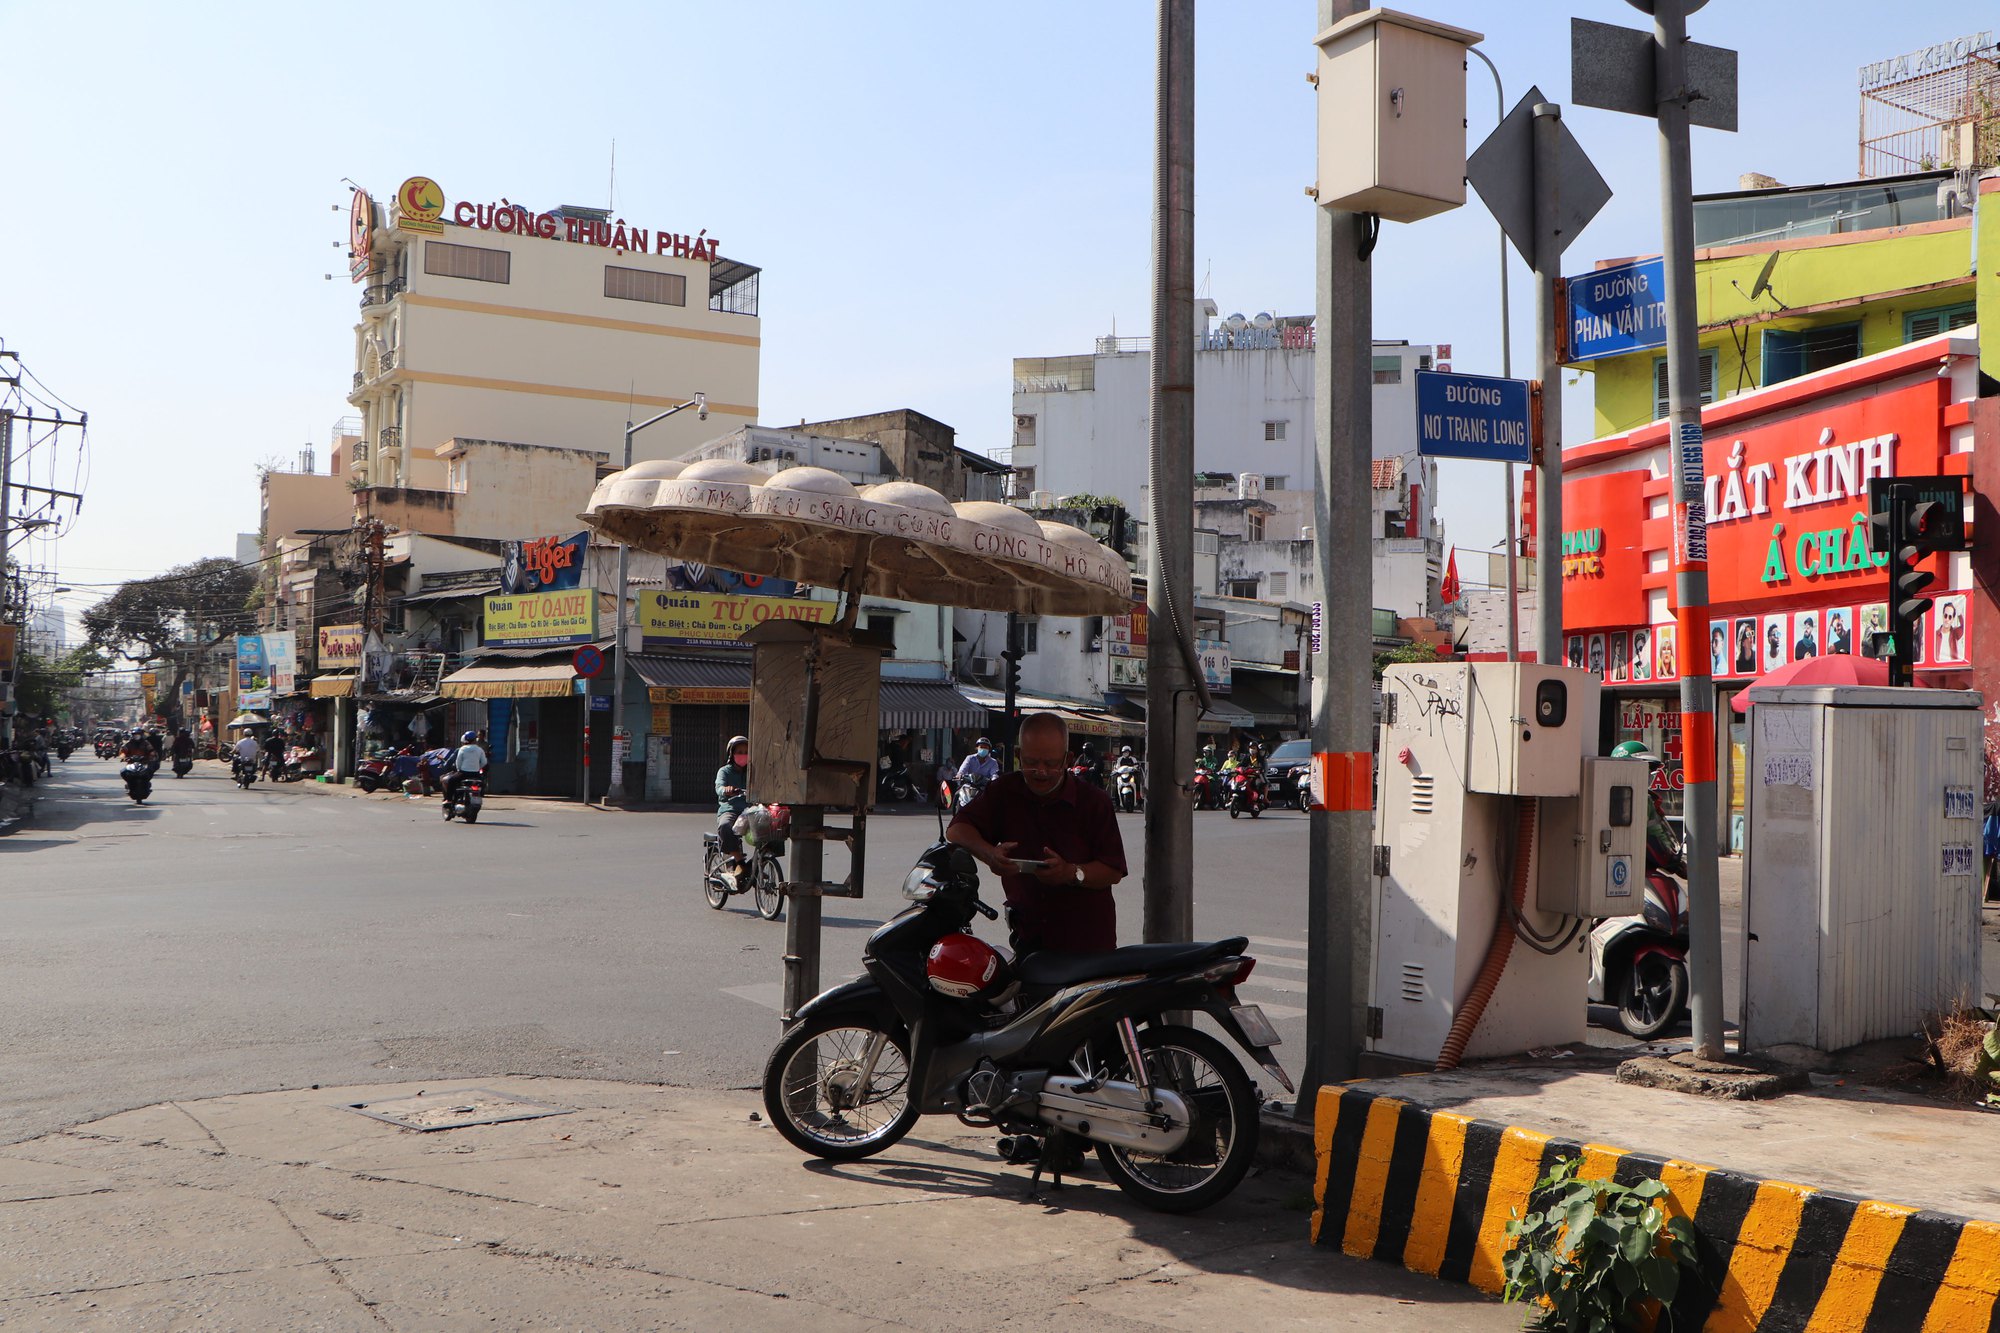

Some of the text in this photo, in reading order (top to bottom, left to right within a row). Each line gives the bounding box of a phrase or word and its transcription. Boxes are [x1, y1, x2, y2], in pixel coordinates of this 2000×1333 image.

[1860, 32, 1989, 88] NHA KHOA
[454, 198, 720, 263] CƯỜNG THUẬN PHÁT
[1594, 274, 1648, 302] ĐƯỜNG
[1575, 313, 1612, 344] PHAN
[1616, 304, 1643, 335] VĂN
[1446, 382, 1502, 406] ĐƯỜNG
[1424, 414, 1524, 446] NƠ TRANG LONG
[1783, 427, 1898, 509] KÍNH
[523, 536, 577, 584] Tiger
[1760, 523, 1788, 583] Á
[489, 595, 587, 620] Quán TƯ OANH
[656, 594, 824, 624] Quán TƯ OANH
[652, 619, 666, 628] Đặc
[669, 620, 684, 629] Biệt
[692, 620, 706, 629] Chả
[1116, 631, 1126, 640] XE
[1622, 704, 1652, 729] LẮP
